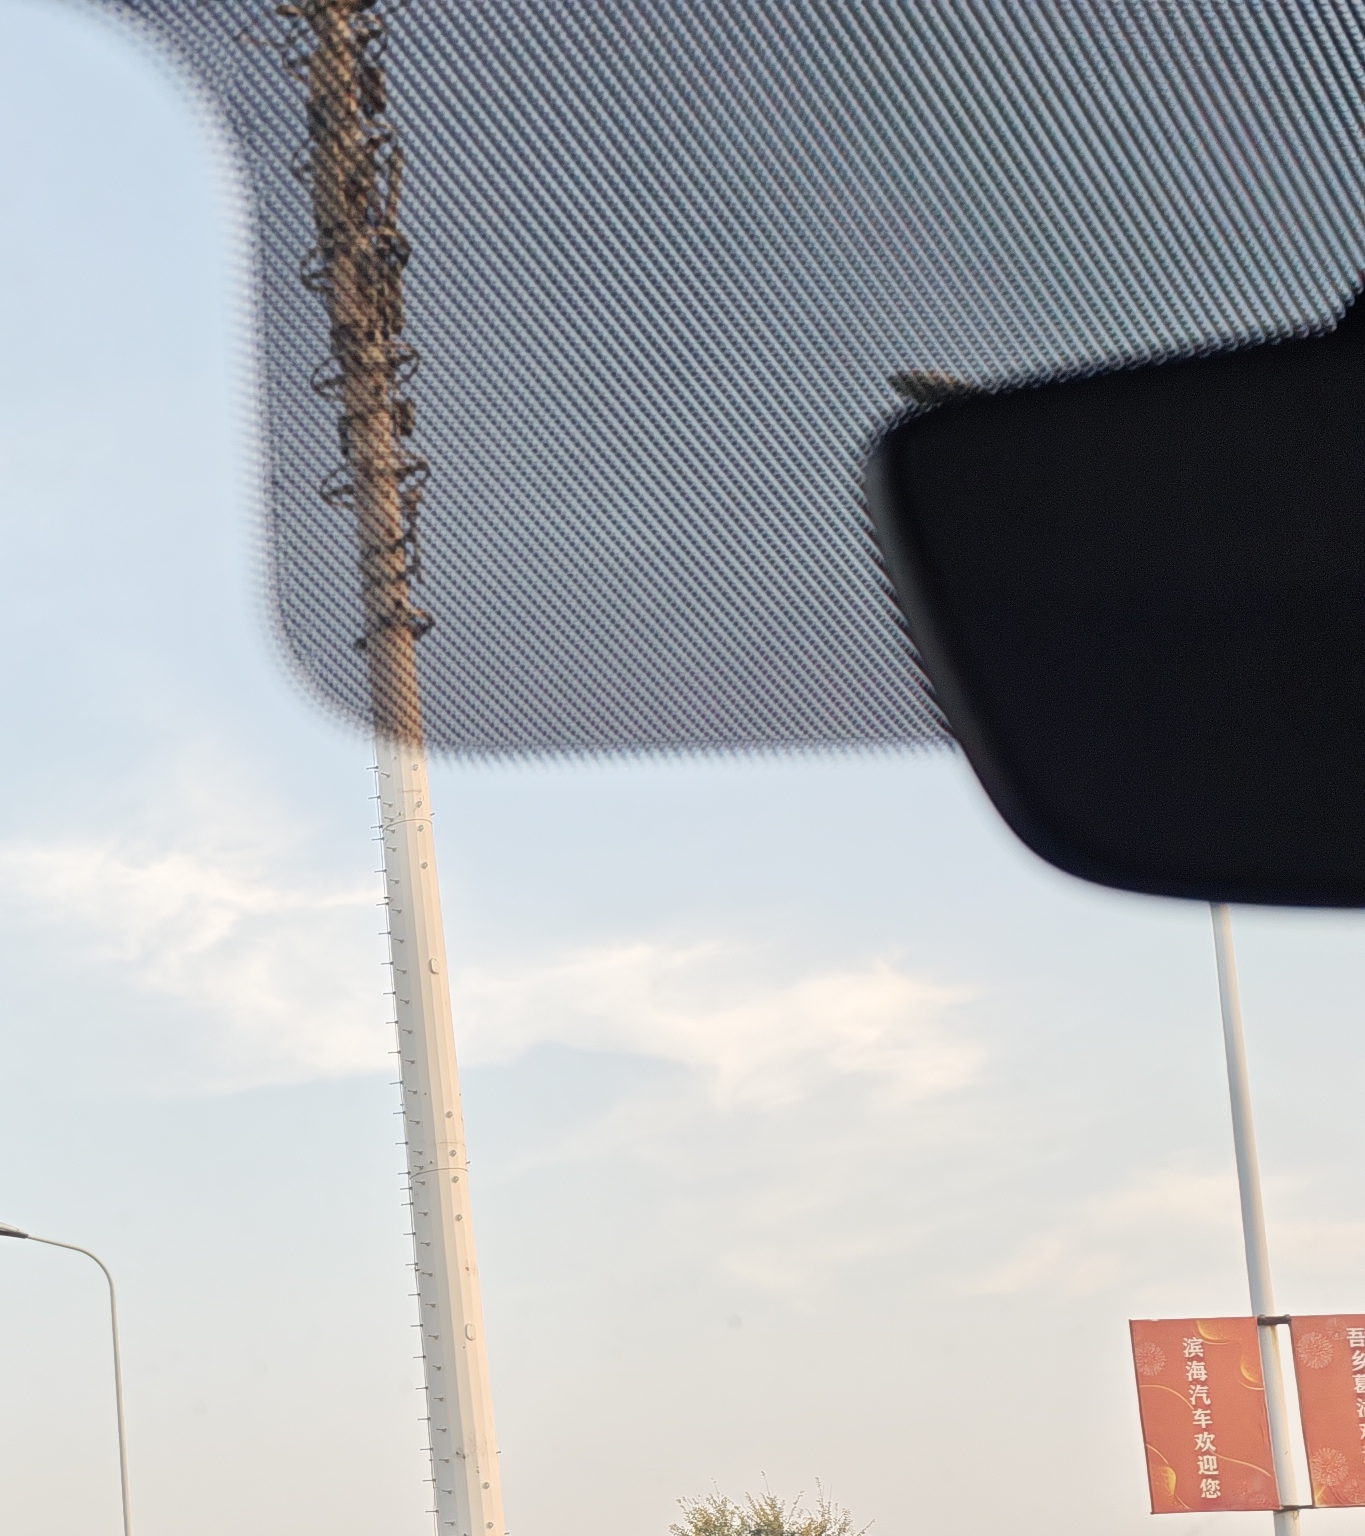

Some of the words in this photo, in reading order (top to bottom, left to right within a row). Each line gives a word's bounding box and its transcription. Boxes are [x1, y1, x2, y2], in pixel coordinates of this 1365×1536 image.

[1182, 1337, 1221, 1499] 滨海汽车欢迎您
